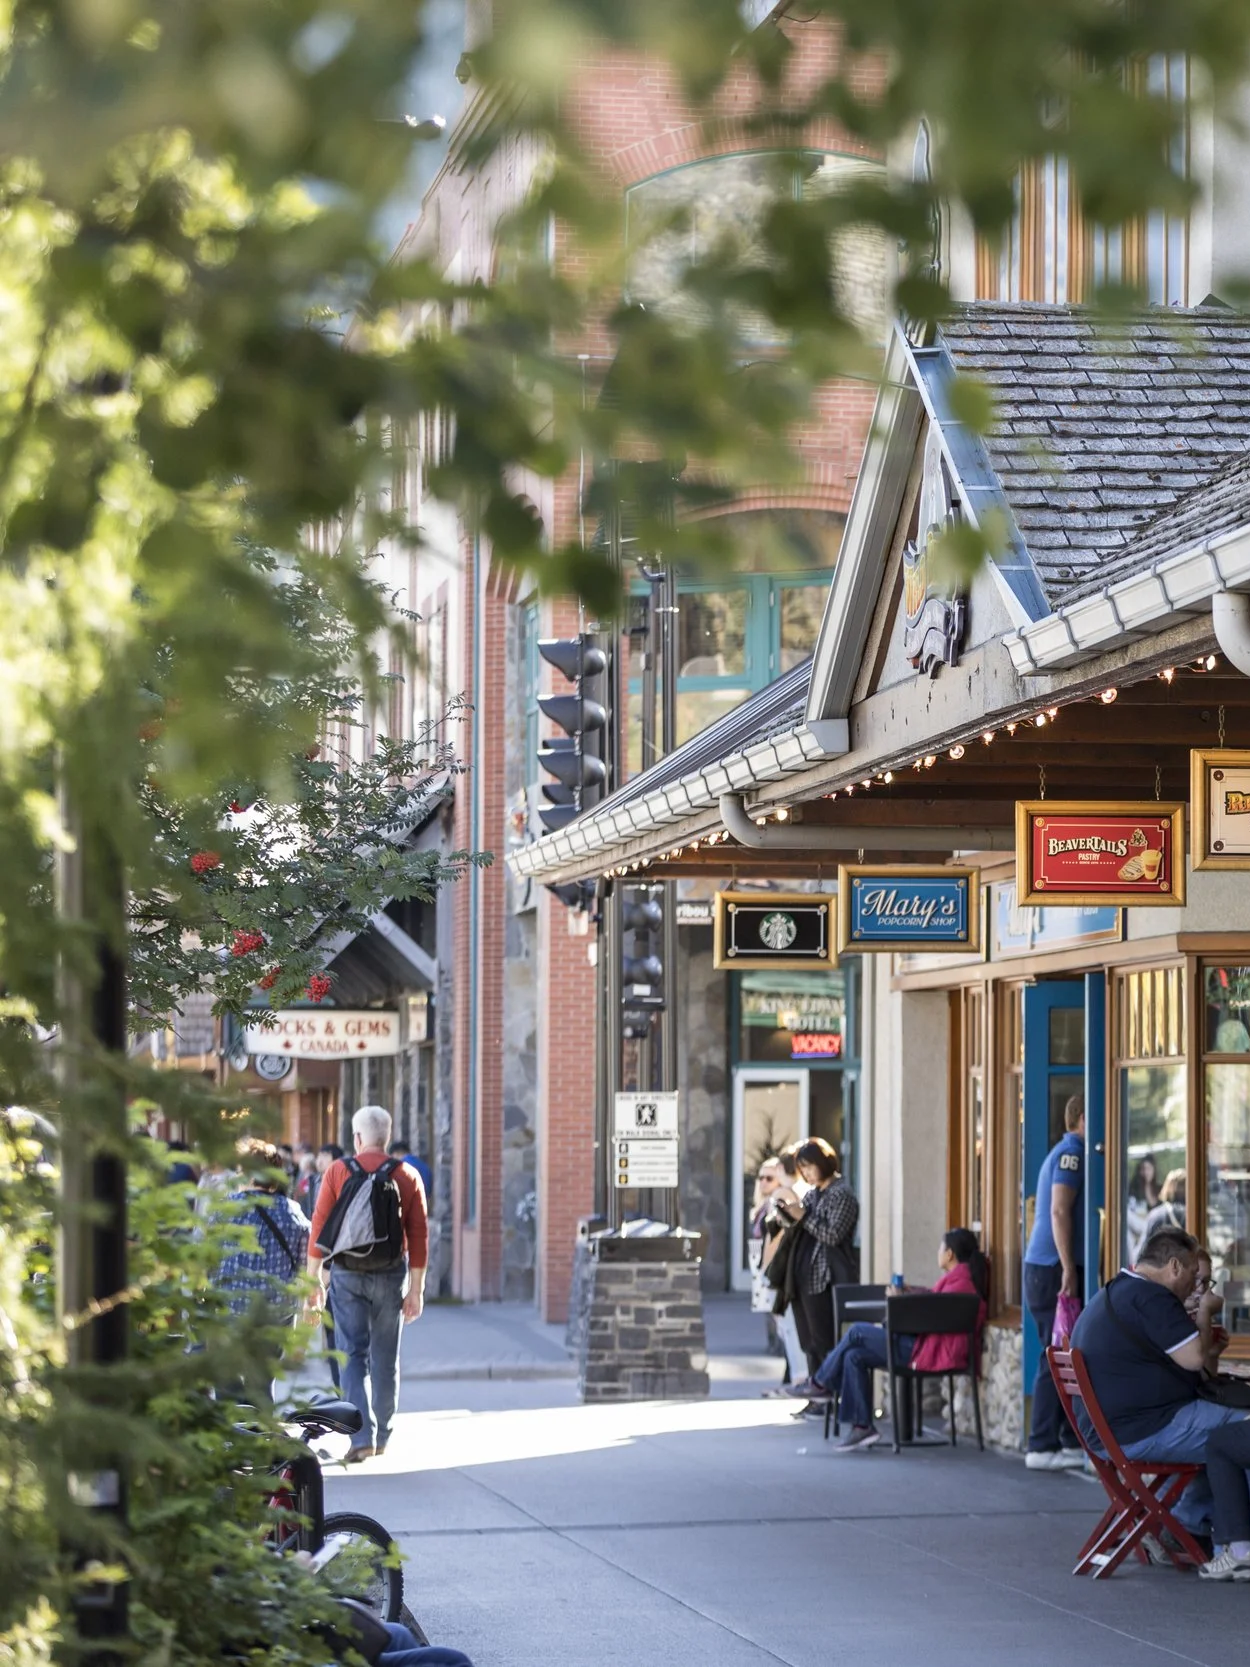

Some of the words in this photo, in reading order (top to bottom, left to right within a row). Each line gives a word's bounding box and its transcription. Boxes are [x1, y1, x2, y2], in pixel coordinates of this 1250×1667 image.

[1078, 853, 1100, 861] PASTRY
[676, 903, 709, 918] ribou
[861, 889, 957, 928] Mary's
[878, 917, 922, 926] POPCORN
[930, 917, 956, 926] SHOP
[323, 1020, 336, 1036] &
[344, 1020, 390, 1037] GEMS
[300, 1040, 349, 1053] CANADA
[1060, 1154, 1079, 1171] 06
